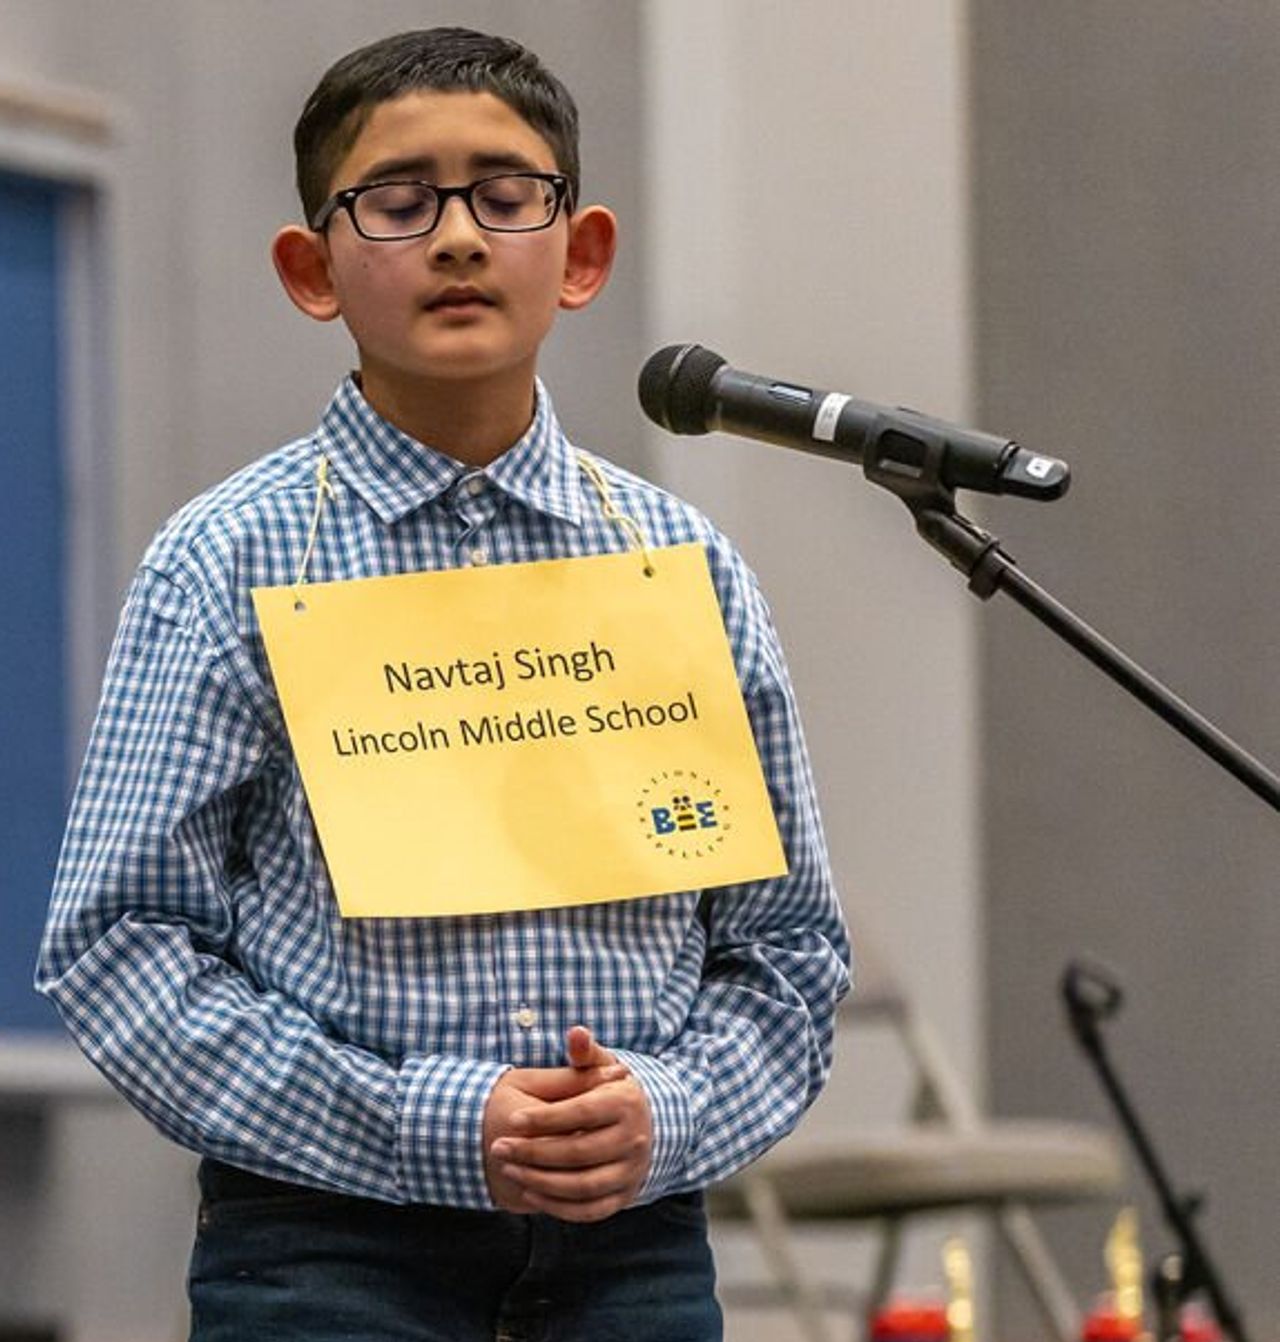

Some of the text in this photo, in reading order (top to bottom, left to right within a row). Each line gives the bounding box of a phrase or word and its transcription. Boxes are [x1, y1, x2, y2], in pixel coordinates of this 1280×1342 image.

[383, 641, 616, 693] Navtaj Singh
[332, 691, 699, 756] Lincoln Middle School
